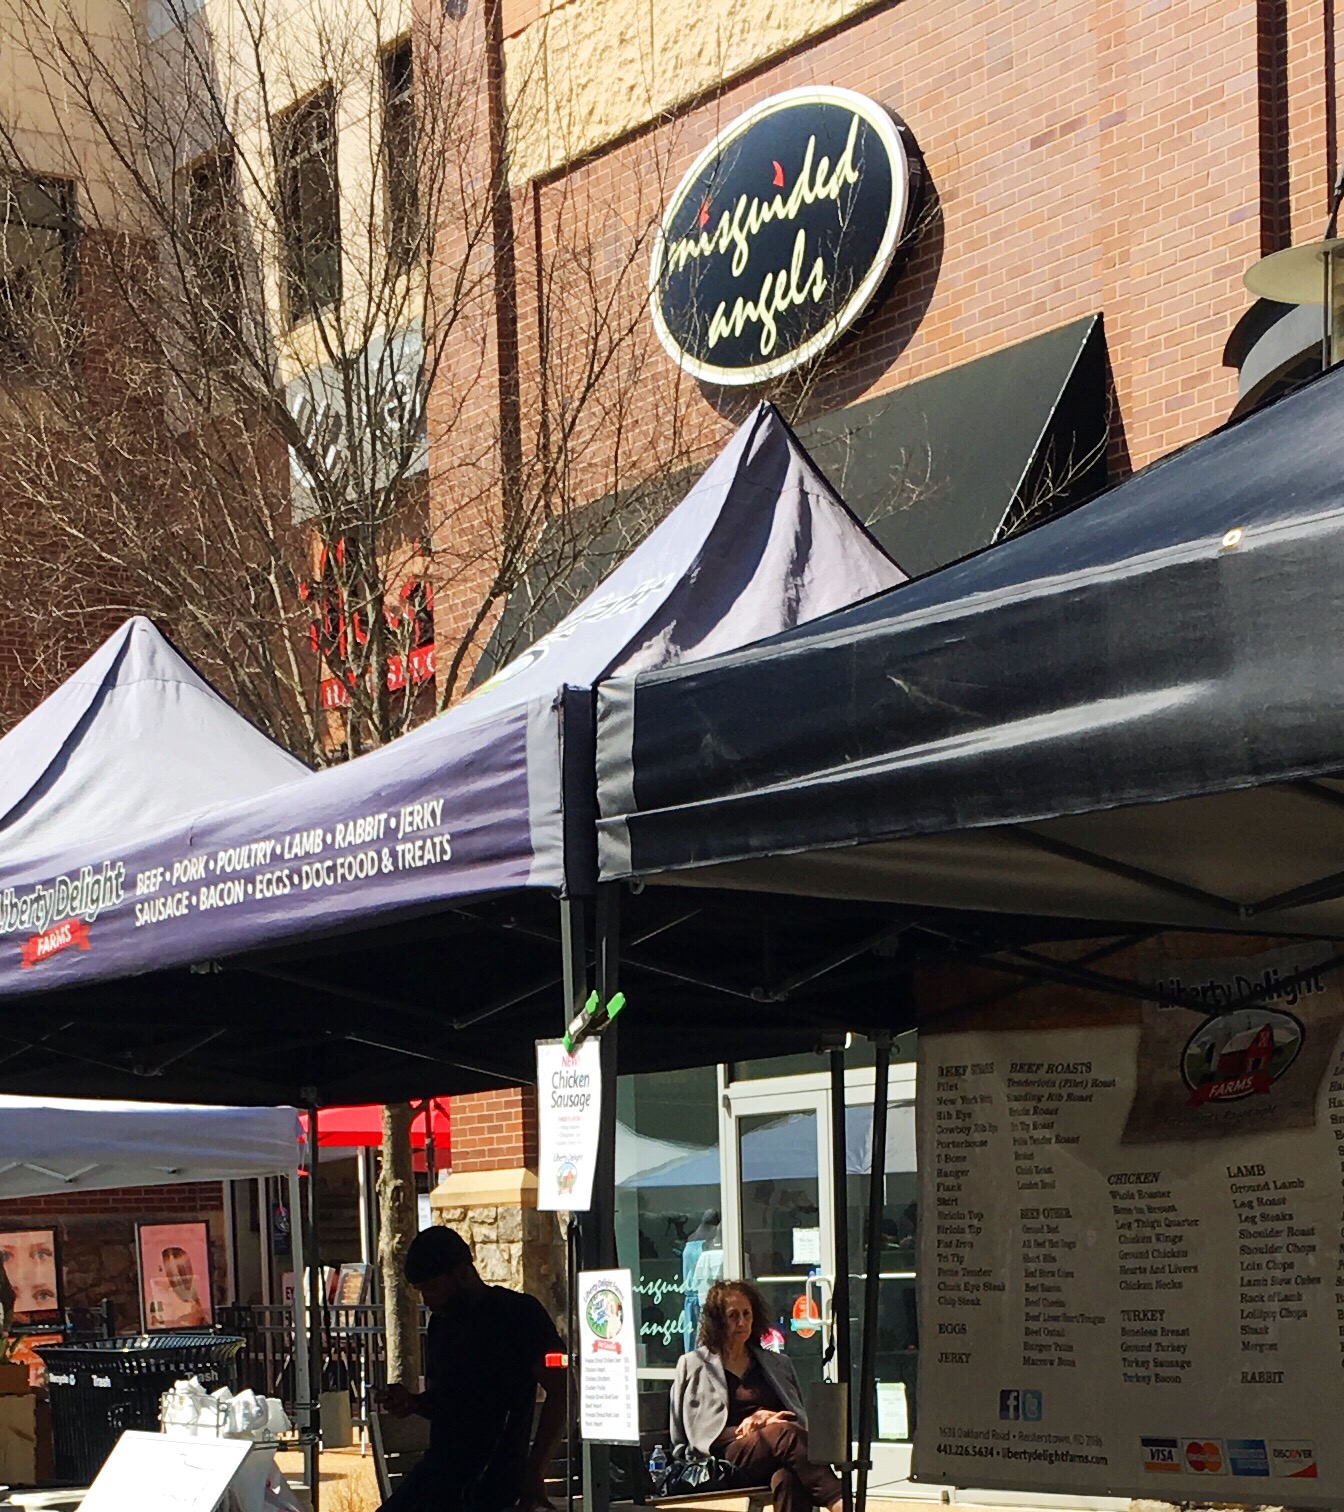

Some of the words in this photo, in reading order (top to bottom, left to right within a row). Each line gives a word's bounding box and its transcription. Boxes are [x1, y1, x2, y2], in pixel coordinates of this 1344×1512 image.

[668, 114, 859, 278] misguided
[708, 228, 827, 356] angels
[136, 866, 164, 896] BEEF
[173, 858, 207, 887] PORK
[216, 840, 275, 874] POULTRY
[284, 828, 323, 860] LAMB
[335, 813, 388, 850] RABBIT
[397, 799, 444, 839] JERKY
[135, 892, 189, 927] SAUSAGE
[199, 879, 245, 912] BACON
[256, 868, 291, 896] EGGS
[302, 860, 334, 891] DOG
[337, 846, 378, 882] FOOD
[381, 845, 395, 871] &
[396, 834, 452, 868] TREATS
[55, 861, 126, 923] Delight
[36, 923, 73, 957] FARMS
[1045, 1061, 1093, 1075] ROASTS
[551, 1069, 590, 1090] Chicken
[1208, 1075, 1254, 1099] FARMS
[551, 1091, 591, 1112] Sausage
[1107, 1170, 1161, 1186] CHICKEN
[1226, 1163, 1267, 1179] LAMB
[1230, 1181, 1270, 1195] Ground
[1273, 1178, 1306, 1191] Lamb
[1120, 1309, 1166, 1322] TURKEY
[640, 1309, 695, 1346] angels
[938, 1322, 968, 1335] EGGS
[937, 1352, 972, 1365] JERKY
[1240, 1370, 1285, 1385] RABBIT
[1150, 1448, 1174, 1462] VISA
